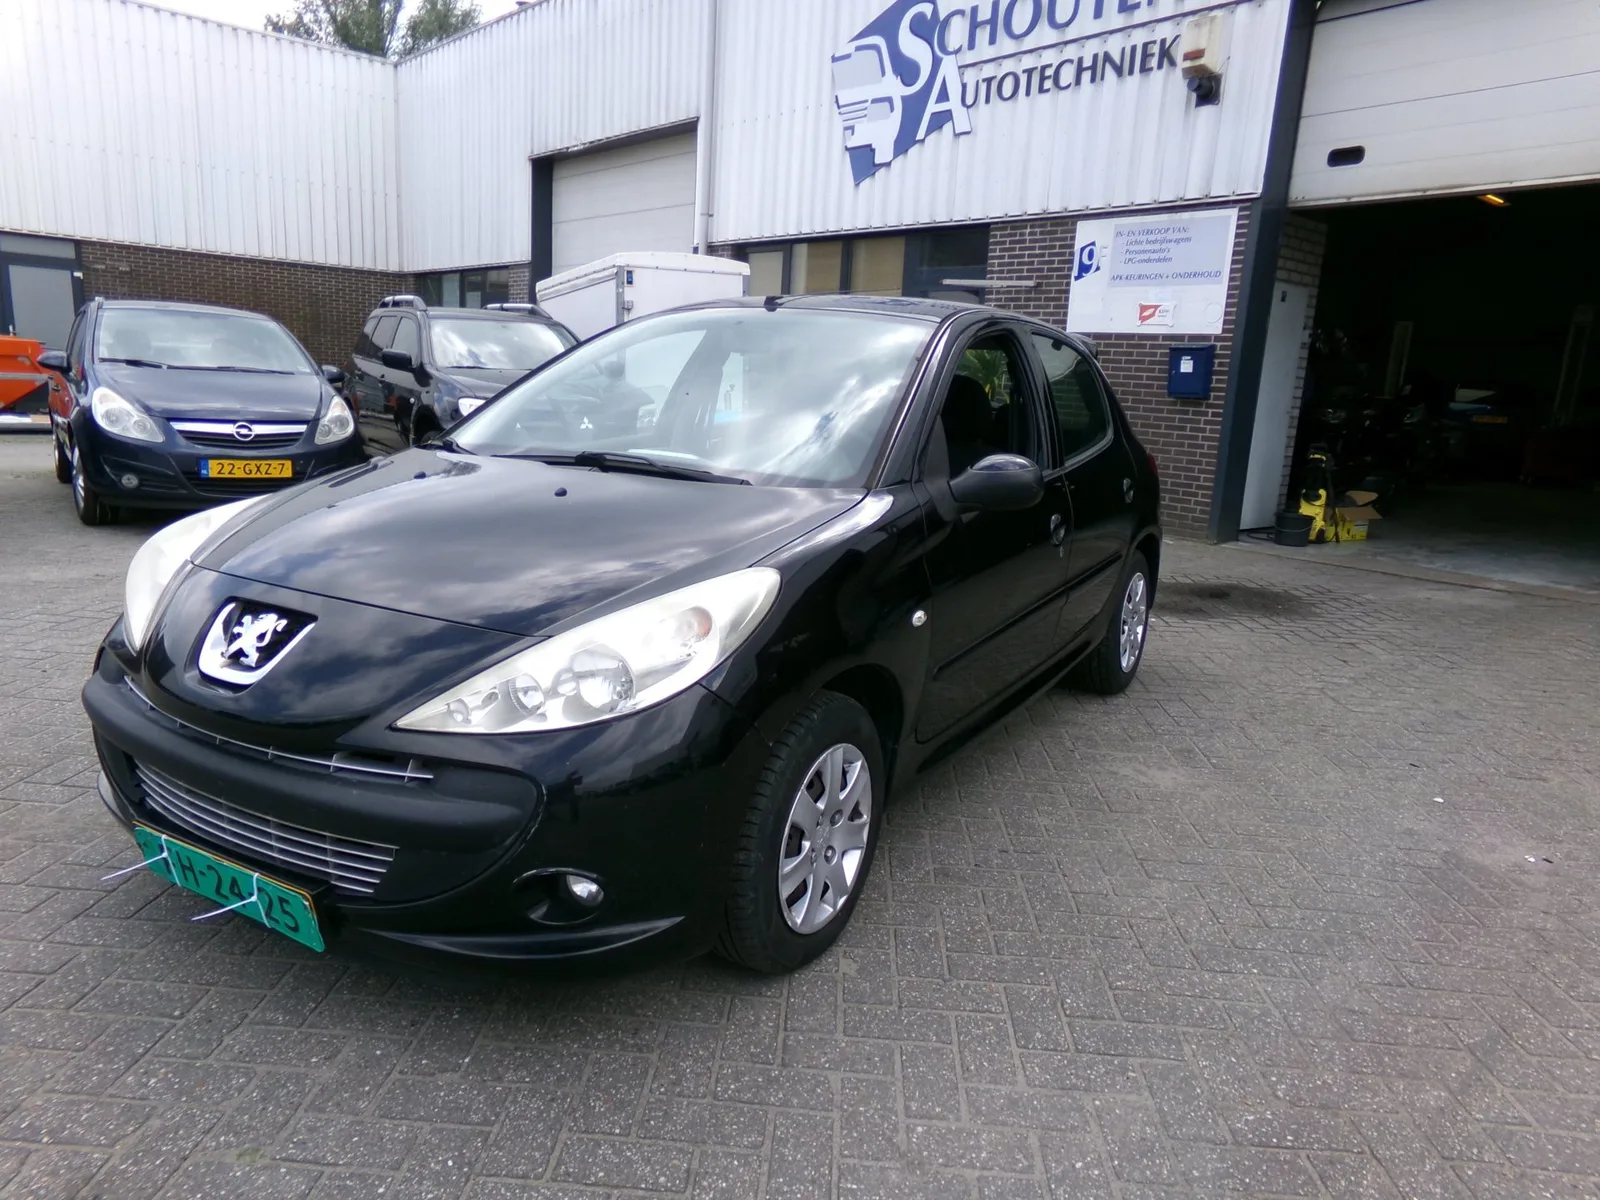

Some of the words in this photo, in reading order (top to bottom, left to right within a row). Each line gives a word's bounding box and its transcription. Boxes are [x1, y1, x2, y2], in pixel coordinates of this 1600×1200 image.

[899, 0, 1154, 96] SCHOU
[916, 34, 1181, 140] AUTOTECHNIEK
[1127, 229, 1136, 237] EN
[1138, 227, 1171, 237] VERKOOP
[1125, 239, 1144, 247] Lichte
[1145, 236, 1192, 246] bedrijfswagens
[1124, 247, 1171, 256] Personenauto's
[1123, 256, 1173, 265] LPG-onderdelen
[1111, 272, 1164, 281] APK-KEURINGEN
[1171, 270, 1222, 279] ONDERHOUD
[216, 462, 286, 476] 22-GXZ-7
